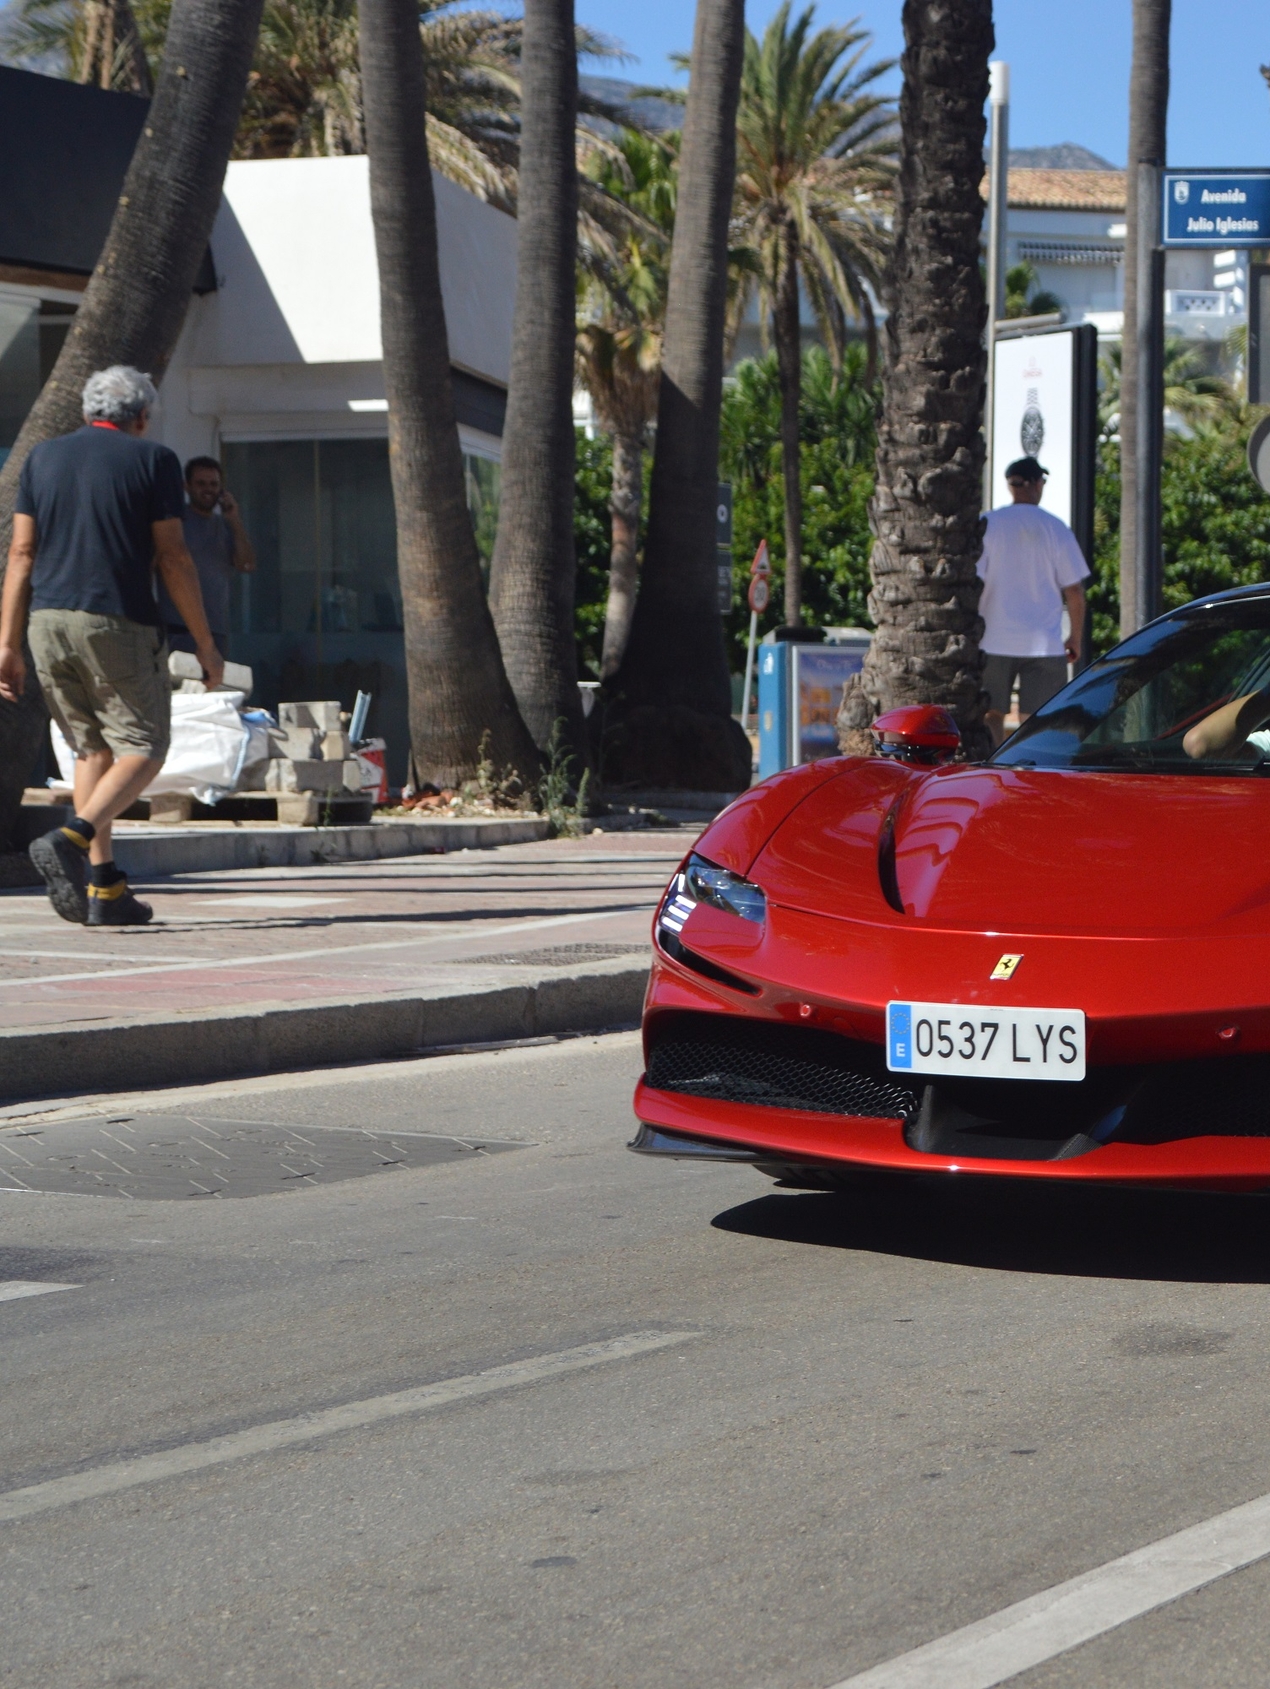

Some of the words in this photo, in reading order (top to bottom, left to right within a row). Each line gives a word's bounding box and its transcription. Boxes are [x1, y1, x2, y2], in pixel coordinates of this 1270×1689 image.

[1201, 188, 1247, 204] Avenida
[1186, 217, 1215, 232] Julio
[1216, 216, 1259, 235] Iglesias
[895, 1043, 906, 1057] E
[916, 1019, 999, 1060] 0537
[1012, 1023, 1077, 1063] LYS
